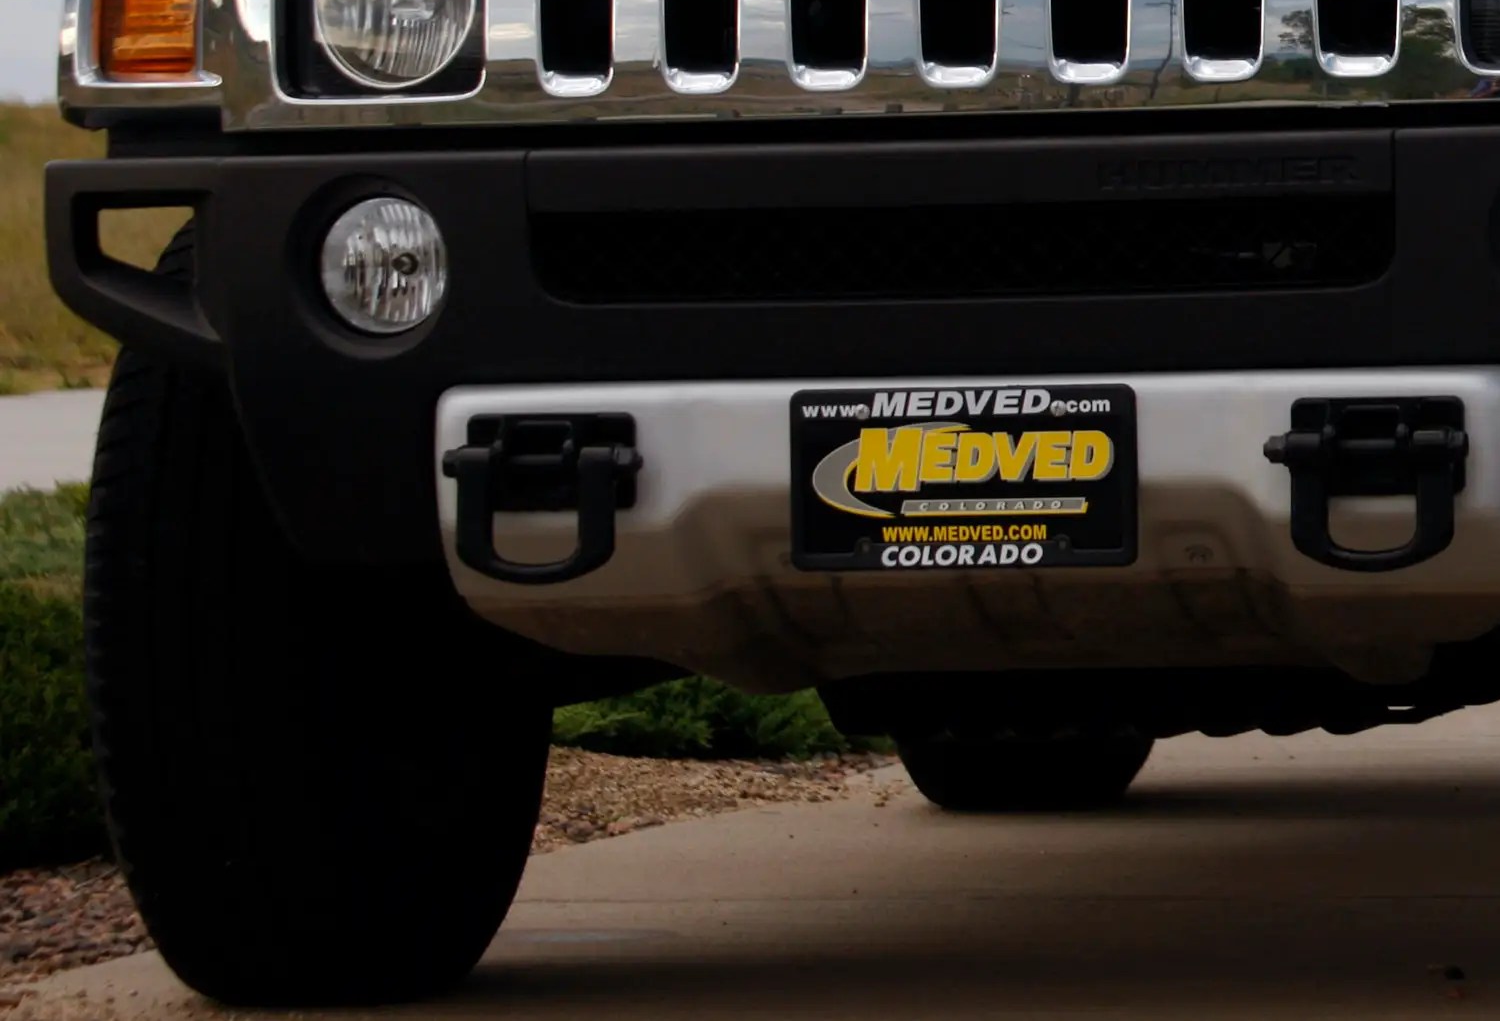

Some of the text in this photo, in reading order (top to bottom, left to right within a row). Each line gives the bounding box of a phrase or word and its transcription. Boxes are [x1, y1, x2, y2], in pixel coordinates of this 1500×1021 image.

[802, 389, 1111, 419] wwwMEDVEDcom
[854, 428, 1114, 492] MEDVED
[919, 499, 1063, 511] COLORADO
[882, 524, 1047, 543] WWW.MEDVED.COM
[881, 542, 1044, 567] COLORADO
